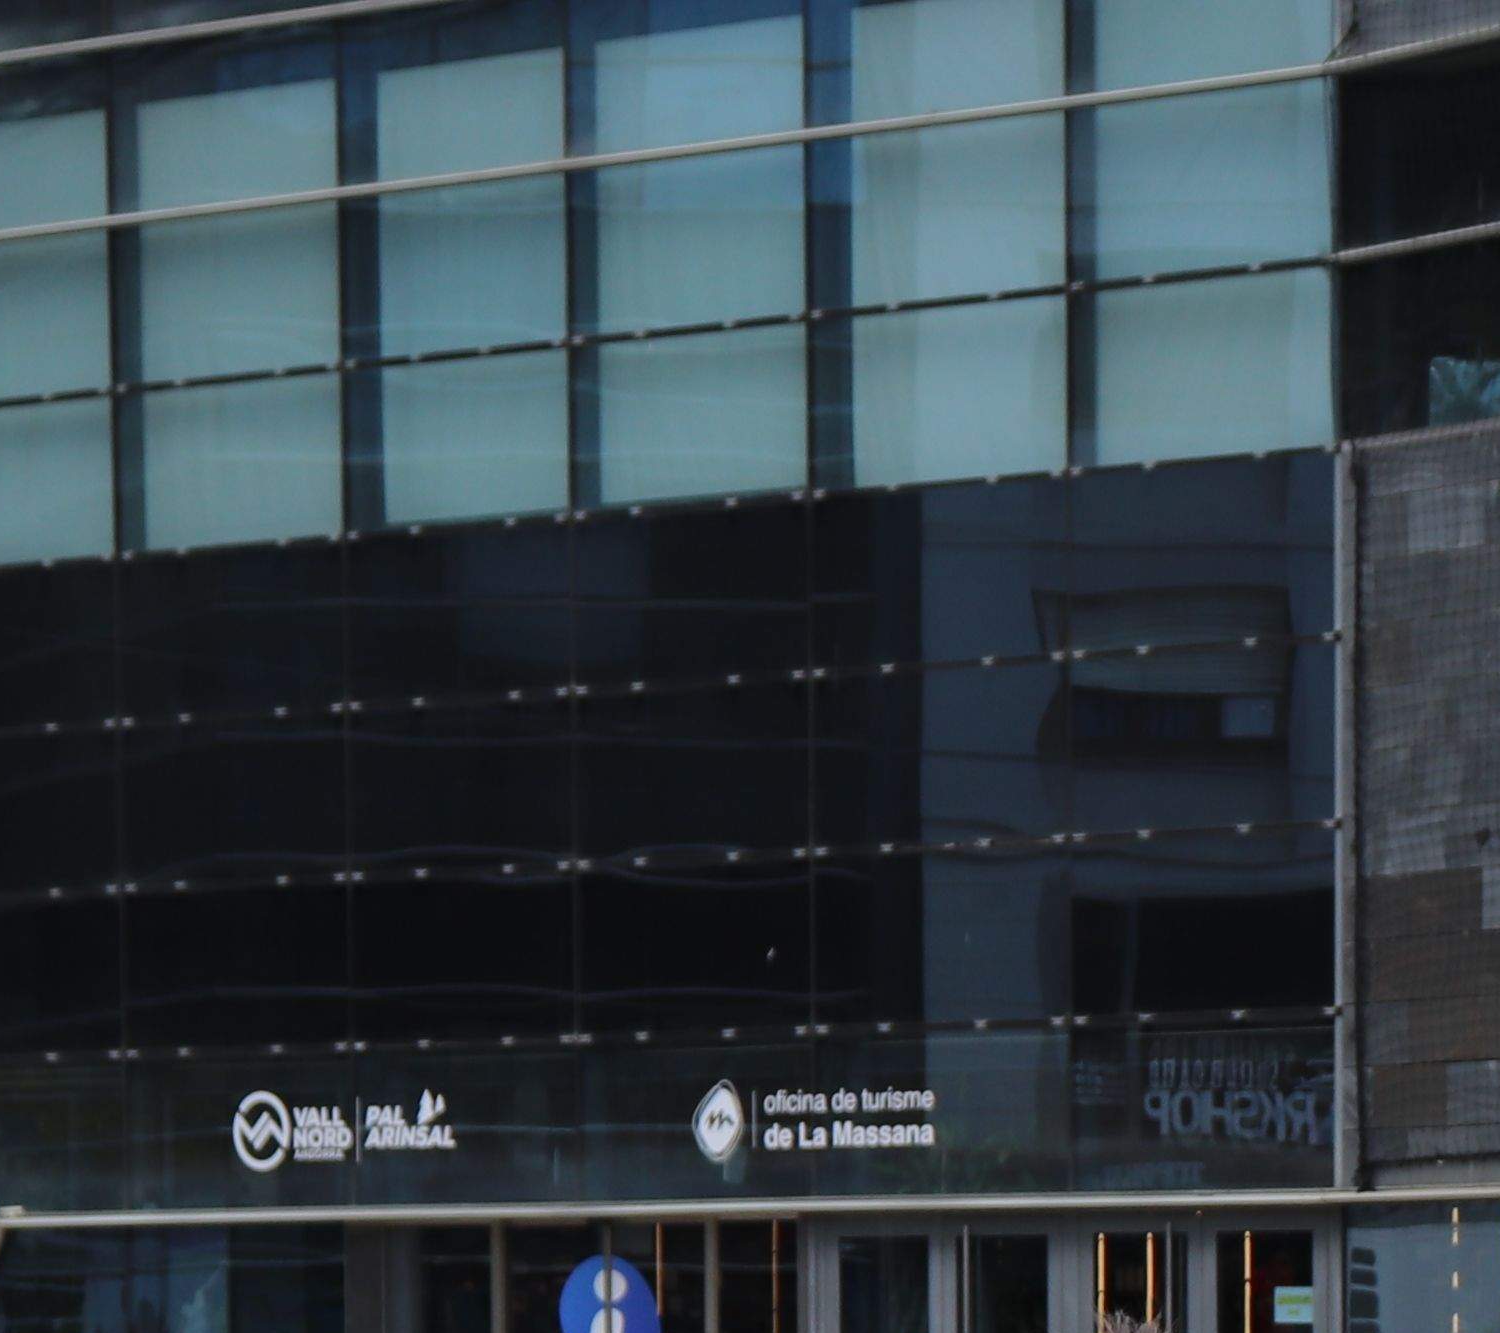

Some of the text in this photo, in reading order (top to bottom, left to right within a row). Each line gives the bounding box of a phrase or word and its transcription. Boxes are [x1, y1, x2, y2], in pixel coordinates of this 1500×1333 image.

[764, 1086, 936, 1115] oficina de turisme
[293, 1105, 345, 1127] VALL
[365, 1105, 406, 1126] PAL
[293, 1127, 353, 1150] NORD
[364, 1125, 457, 1149] ARINSAL
[763, 1120, 936, 1149] de La Massana
